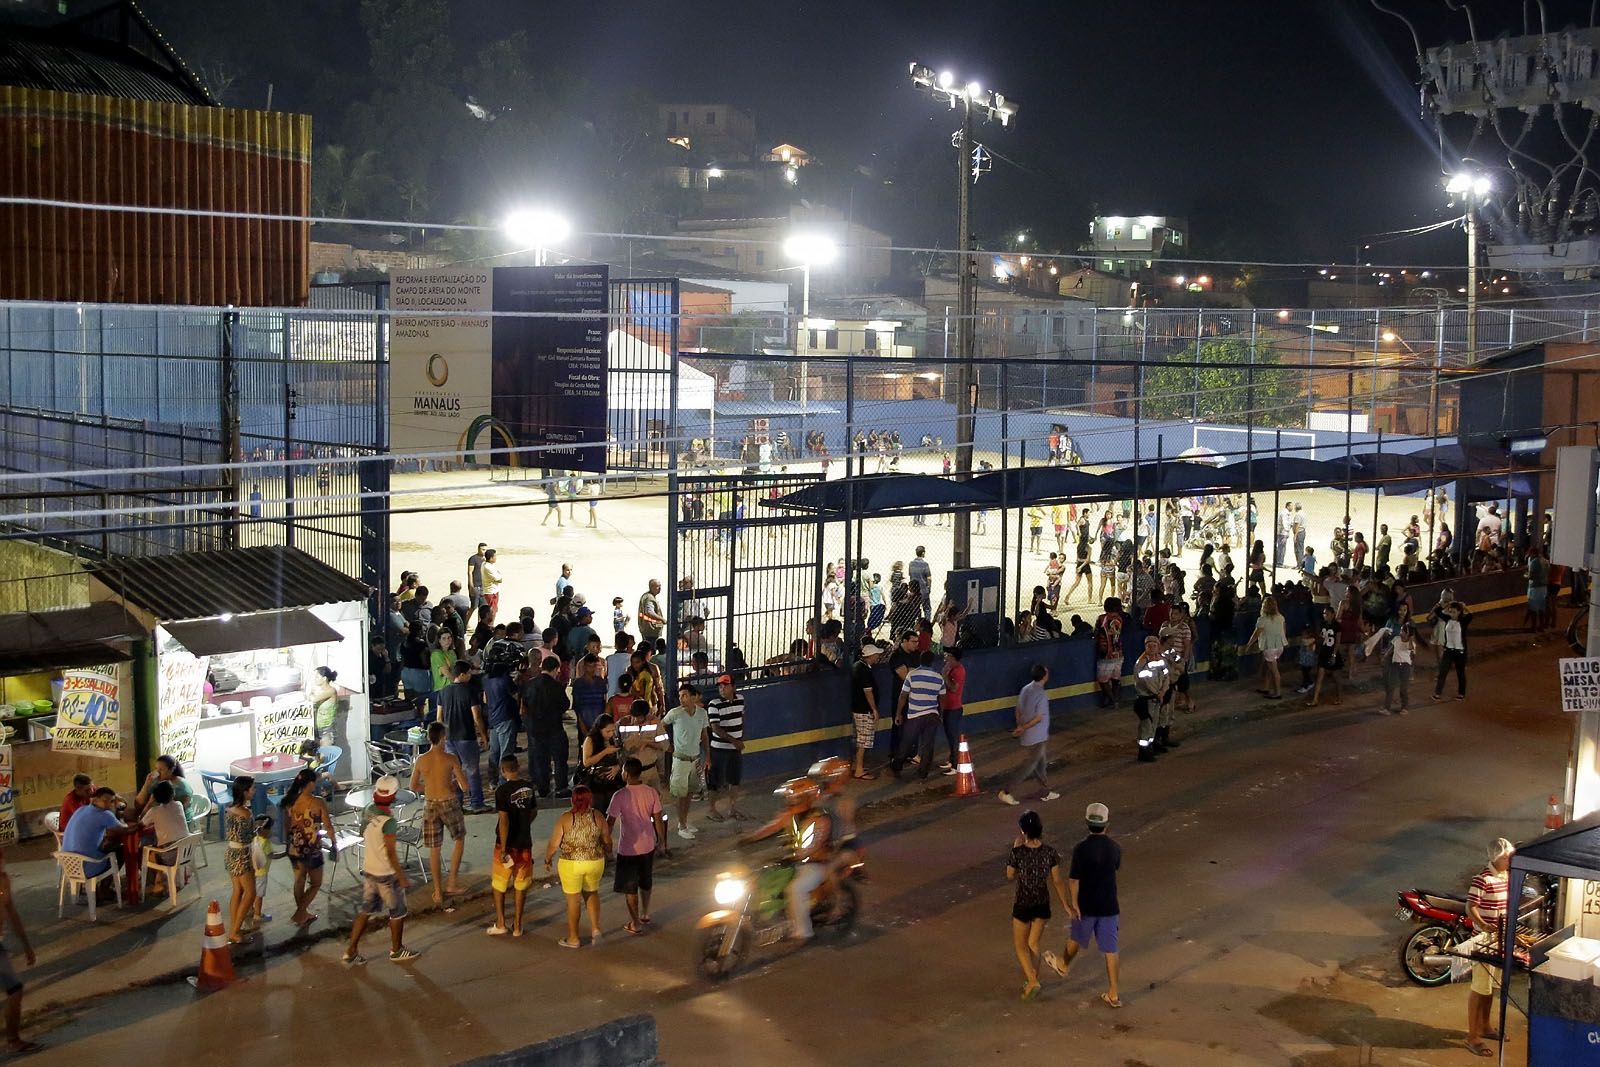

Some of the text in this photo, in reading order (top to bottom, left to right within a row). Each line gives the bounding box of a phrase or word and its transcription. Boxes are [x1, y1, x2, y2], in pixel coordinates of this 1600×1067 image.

[396, 275, 422, 284] REFORMA
[425, 276, 429, 284] E
[476, 275, 487, 283] DO
[396, 287, 481, 295] CAMPO DE AREIA DO MONTE
[418, 298, 456, 306] LOCALIZADO
[396, 319, 417, 328] BAIRRO
[417, 320, 440, 328] MONTE
[461, 320, 488, 328] MANAUS
[396, 329, 430, 338] AMAZONAS
[414, 397, 461, 412] MANAUS
[88, 730, 98, 740] DE
